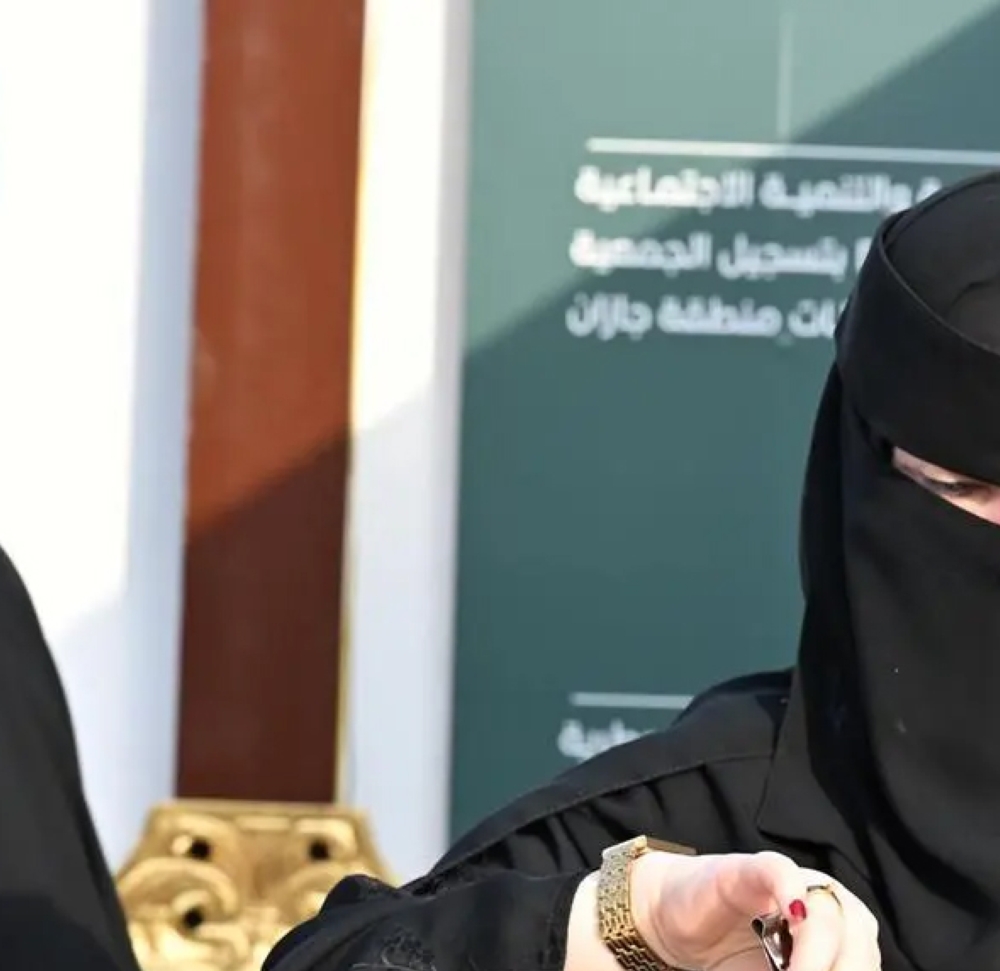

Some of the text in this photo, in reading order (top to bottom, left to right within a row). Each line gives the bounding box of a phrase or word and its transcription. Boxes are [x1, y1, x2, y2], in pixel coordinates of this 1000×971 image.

[574, 165, 753, 212] الاجتماعية
[568, 231, 711, 277] الجمعية
[717, 234, 848, 282] بتسجيل
[565, 293, 654, 340] جازان
[656, 296, 782, 336] منطقة
